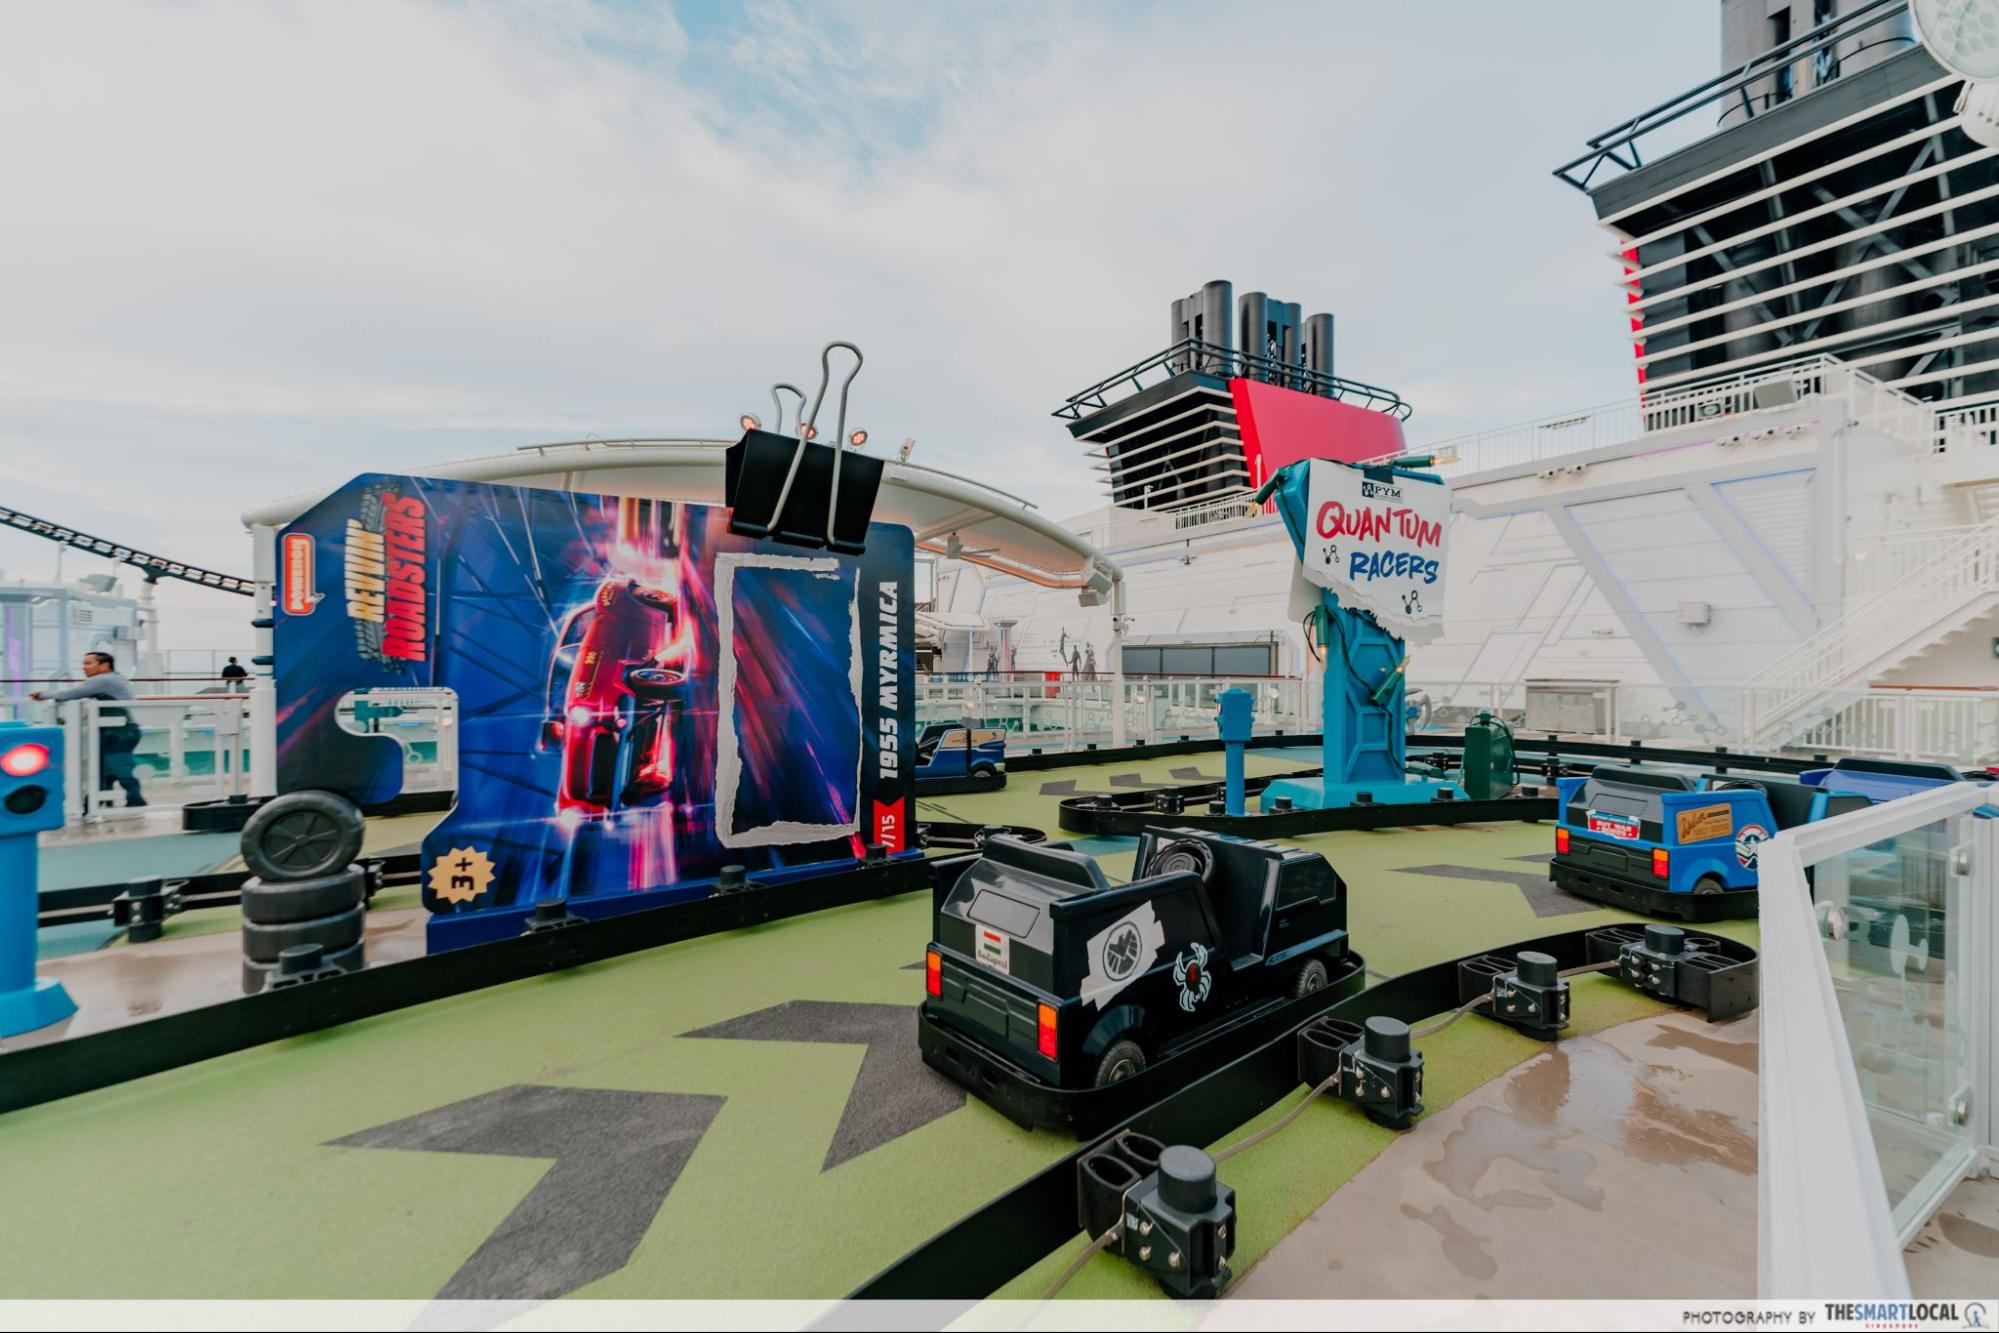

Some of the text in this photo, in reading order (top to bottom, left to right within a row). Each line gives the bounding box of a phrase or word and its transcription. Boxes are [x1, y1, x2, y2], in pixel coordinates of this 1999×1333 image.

[1375, 486, 1401, 498] PYM
[1316, 501, 1442, 548] QUANTUM
[344, 518, 385, 624] REVVIN'
[381, 491, 426, 662] ROADSTERS
[1350, 550, 1440, 584] RACERS
[880, 581, 898, 779] 1955 MYRMICA
[451, 857, 474, 891] 3+
